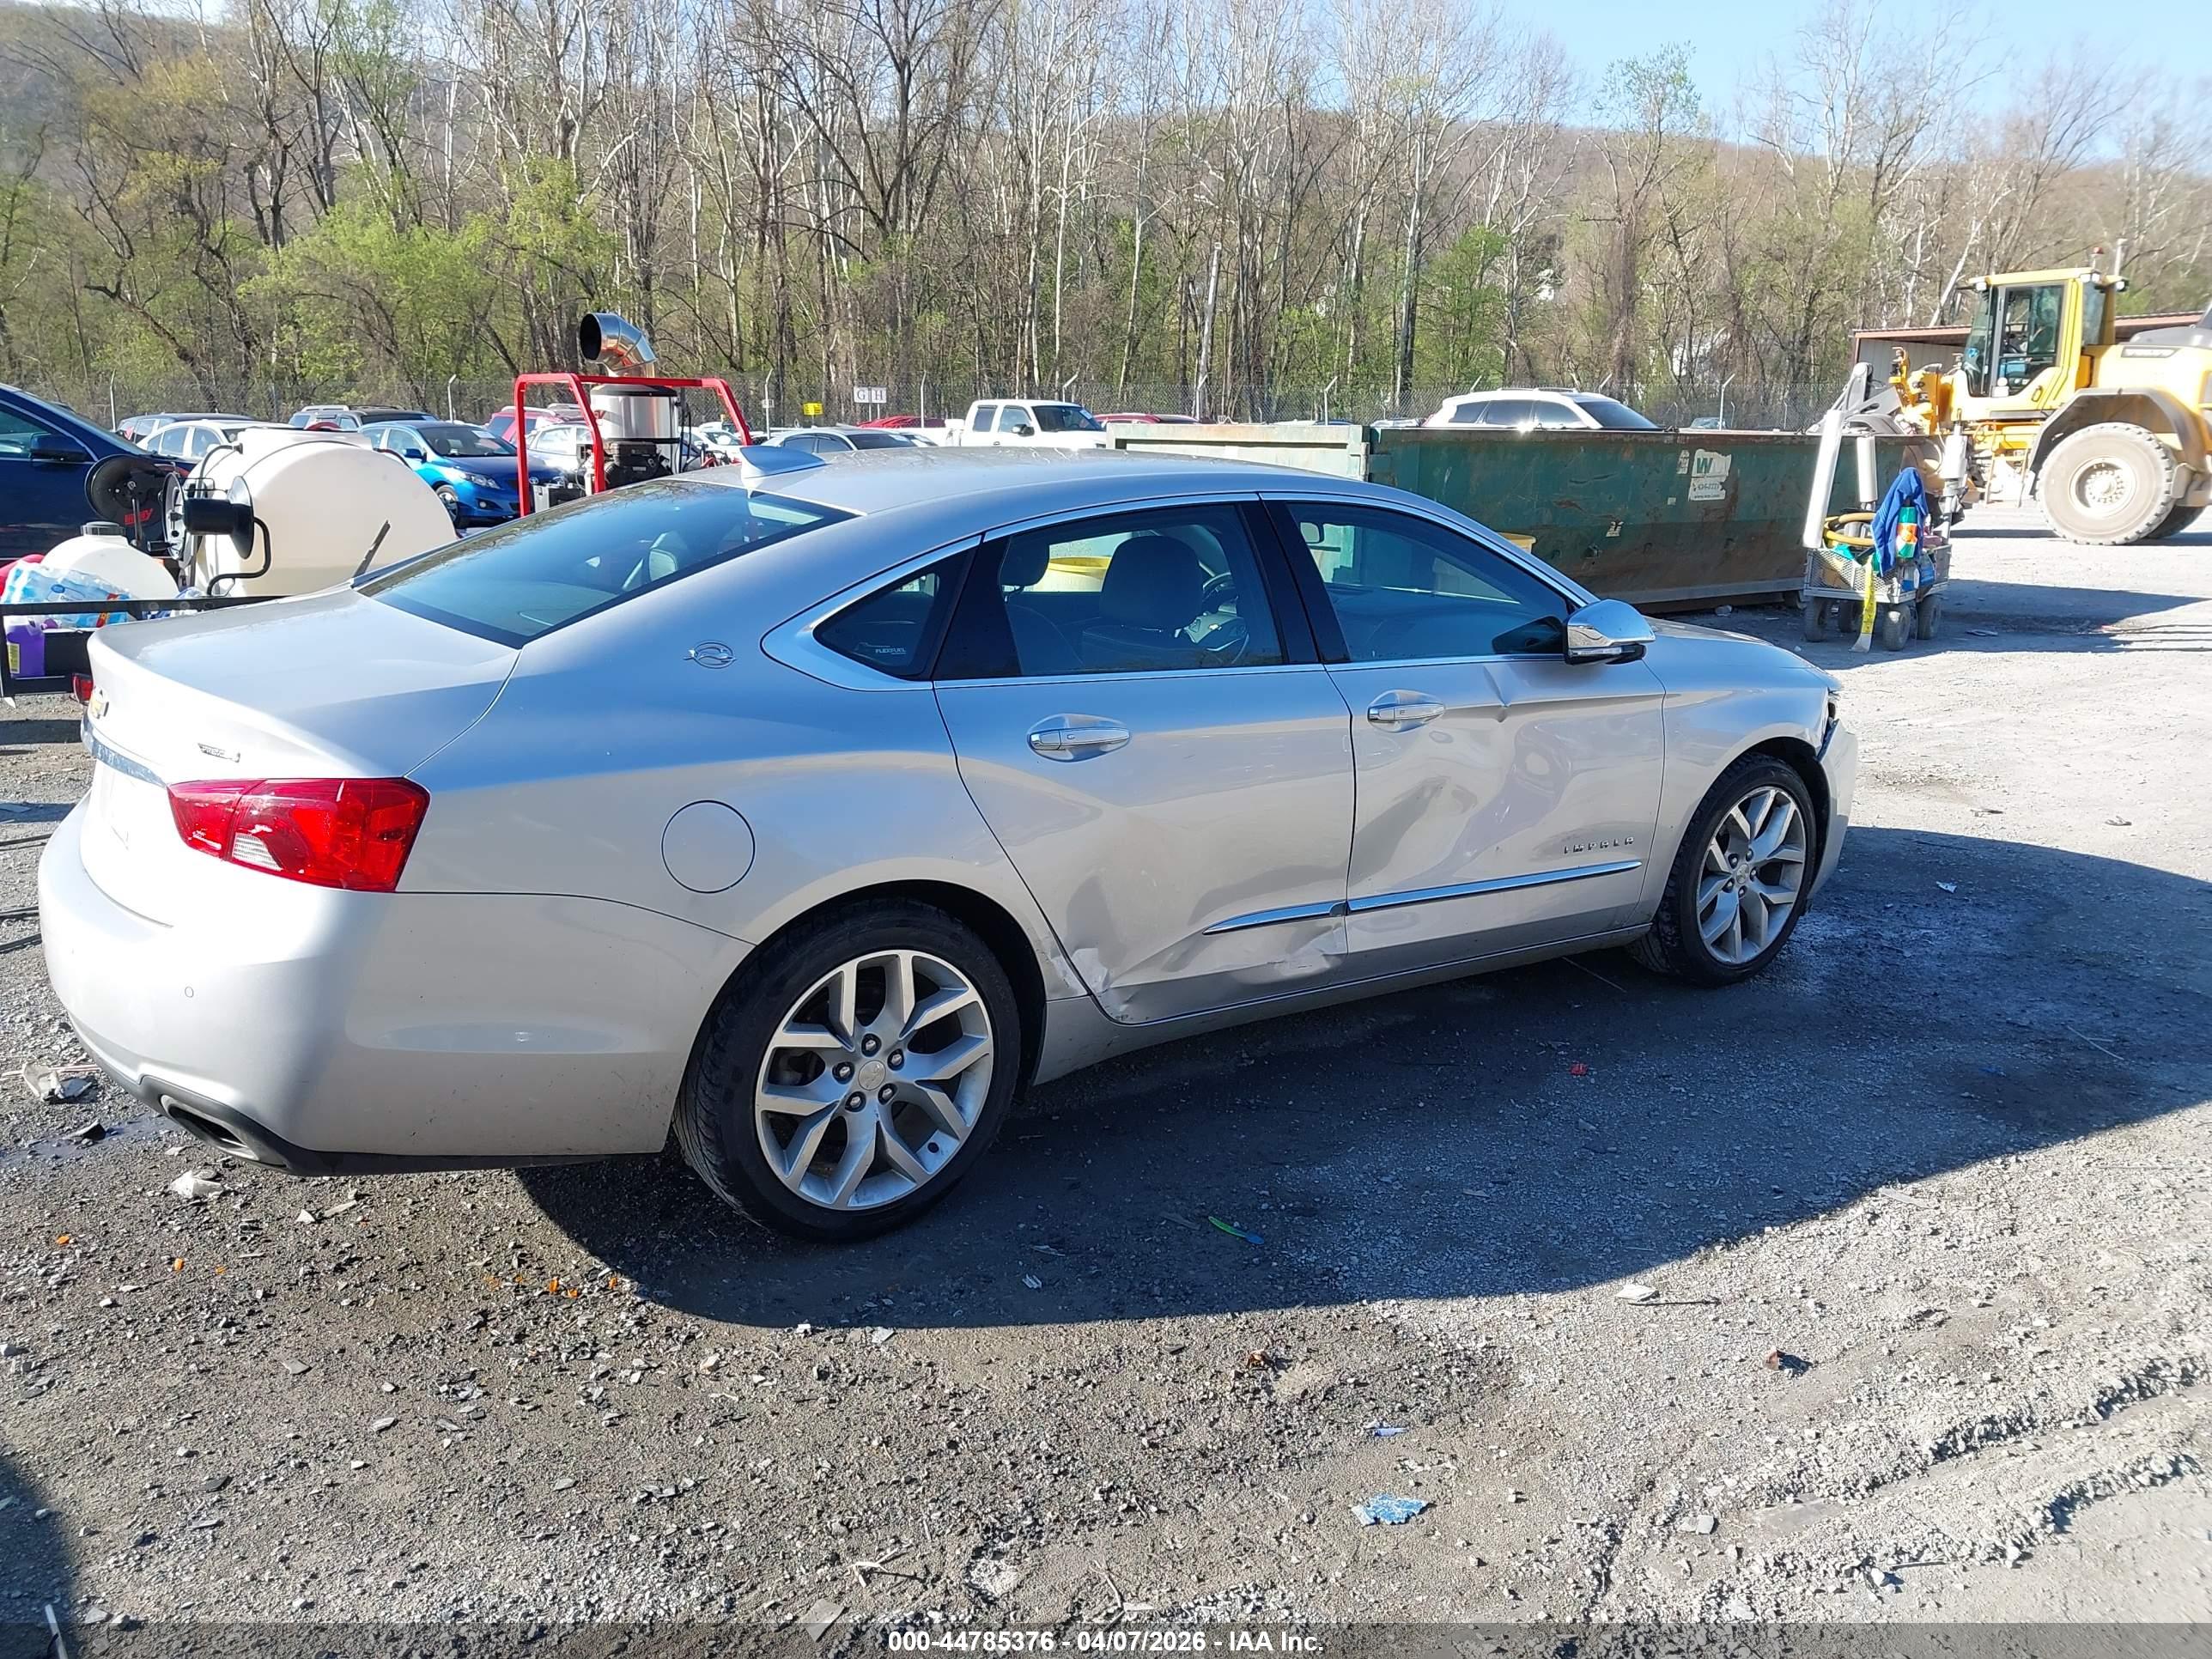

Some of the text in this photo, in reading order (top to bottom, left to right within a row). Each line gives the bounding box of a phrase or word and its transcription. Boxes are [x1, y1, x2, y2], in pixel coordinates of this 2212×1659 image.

[857, 390, 866, 401] G
[874, 390, 883, 401] H
[1564, 836, 1634, 854] IMPALA
